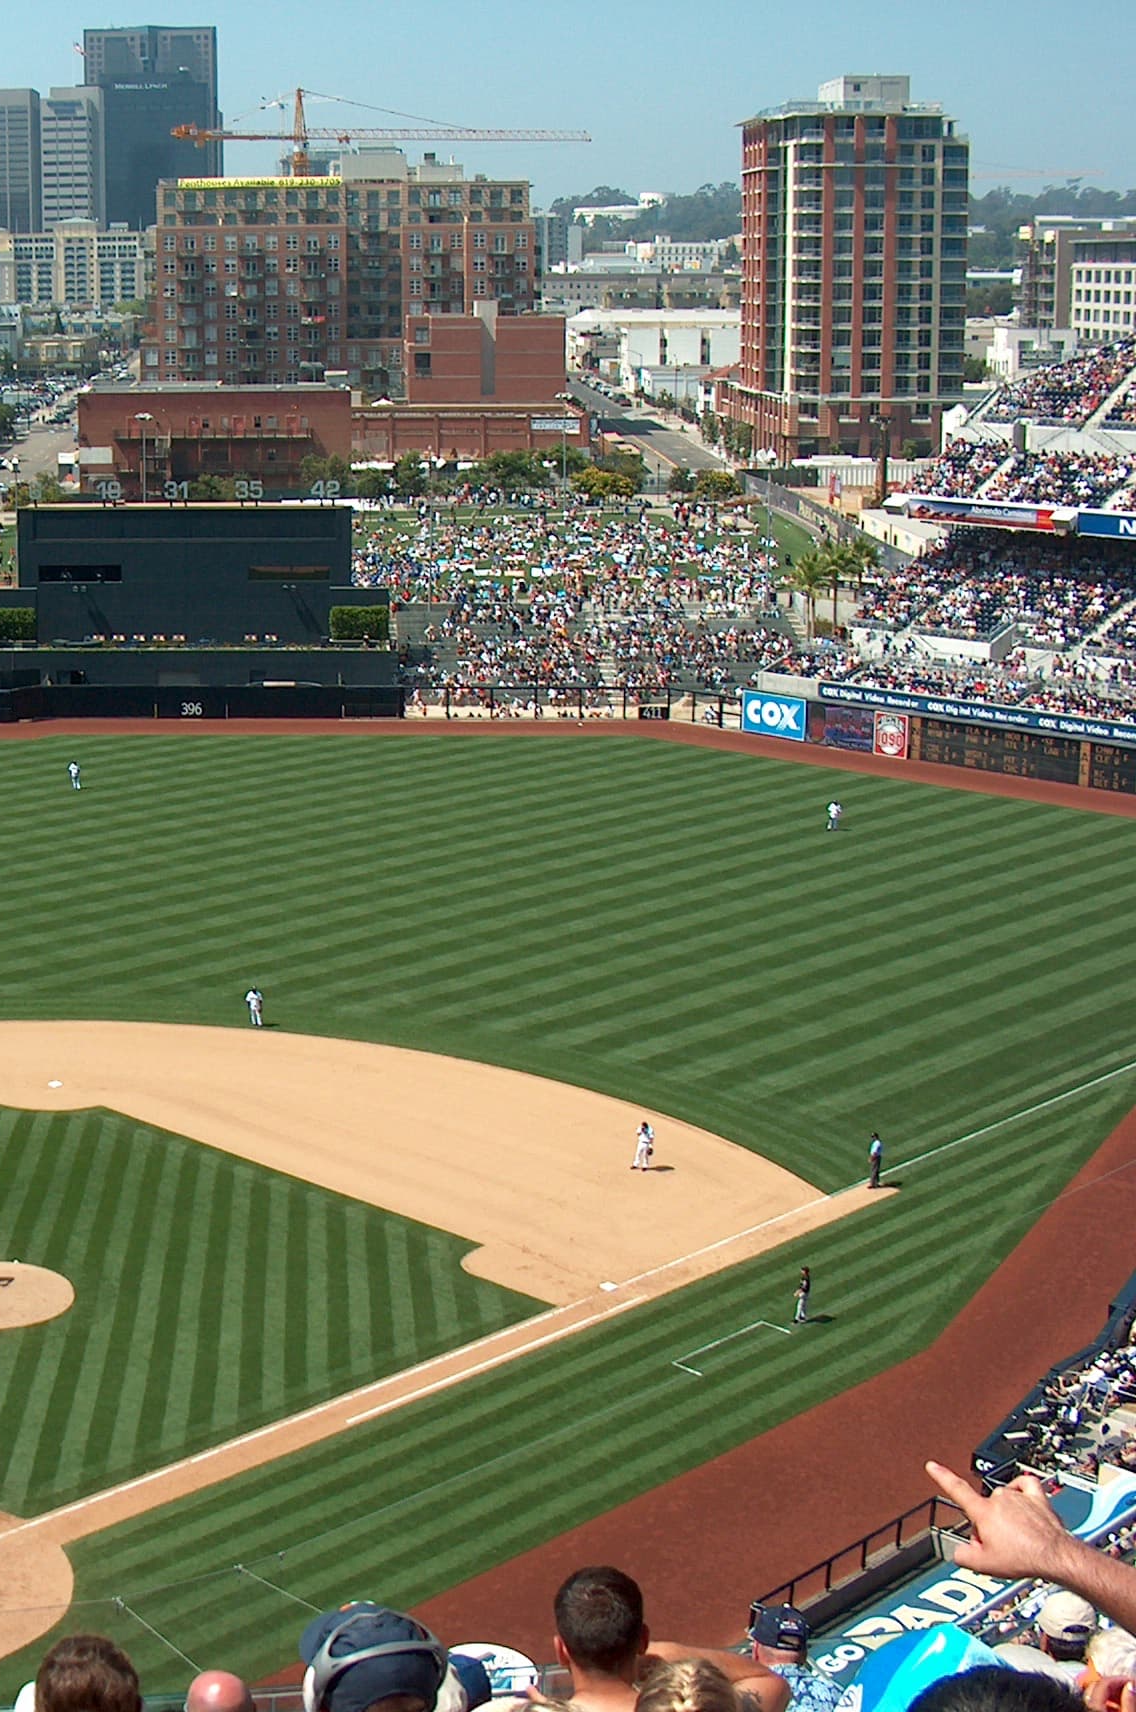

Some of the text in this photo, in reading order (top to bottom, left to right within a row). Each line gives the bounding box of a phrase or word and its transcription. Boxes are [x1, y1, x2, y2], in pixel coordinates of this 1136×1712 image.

[234, 178, 275, 187] Available
[97, 481, 122, 500] 19
[164, 481, 189, 499] 31
[235, 480, 263, 499] 35
[310, 480, 340, 498] 42
[822, 687, 919, 708] COX Digital Video Recorder
[180, 702, 203, 716] 396
[745, 699, 800, 731] COX
[927, 702, 1029, 724] COX Digital Video Recorder
[1038, 718, 1109, 736] COX Digital Video
[877, 731, 903, 747] 1090
[816, 1644, 865, 1673] GO
